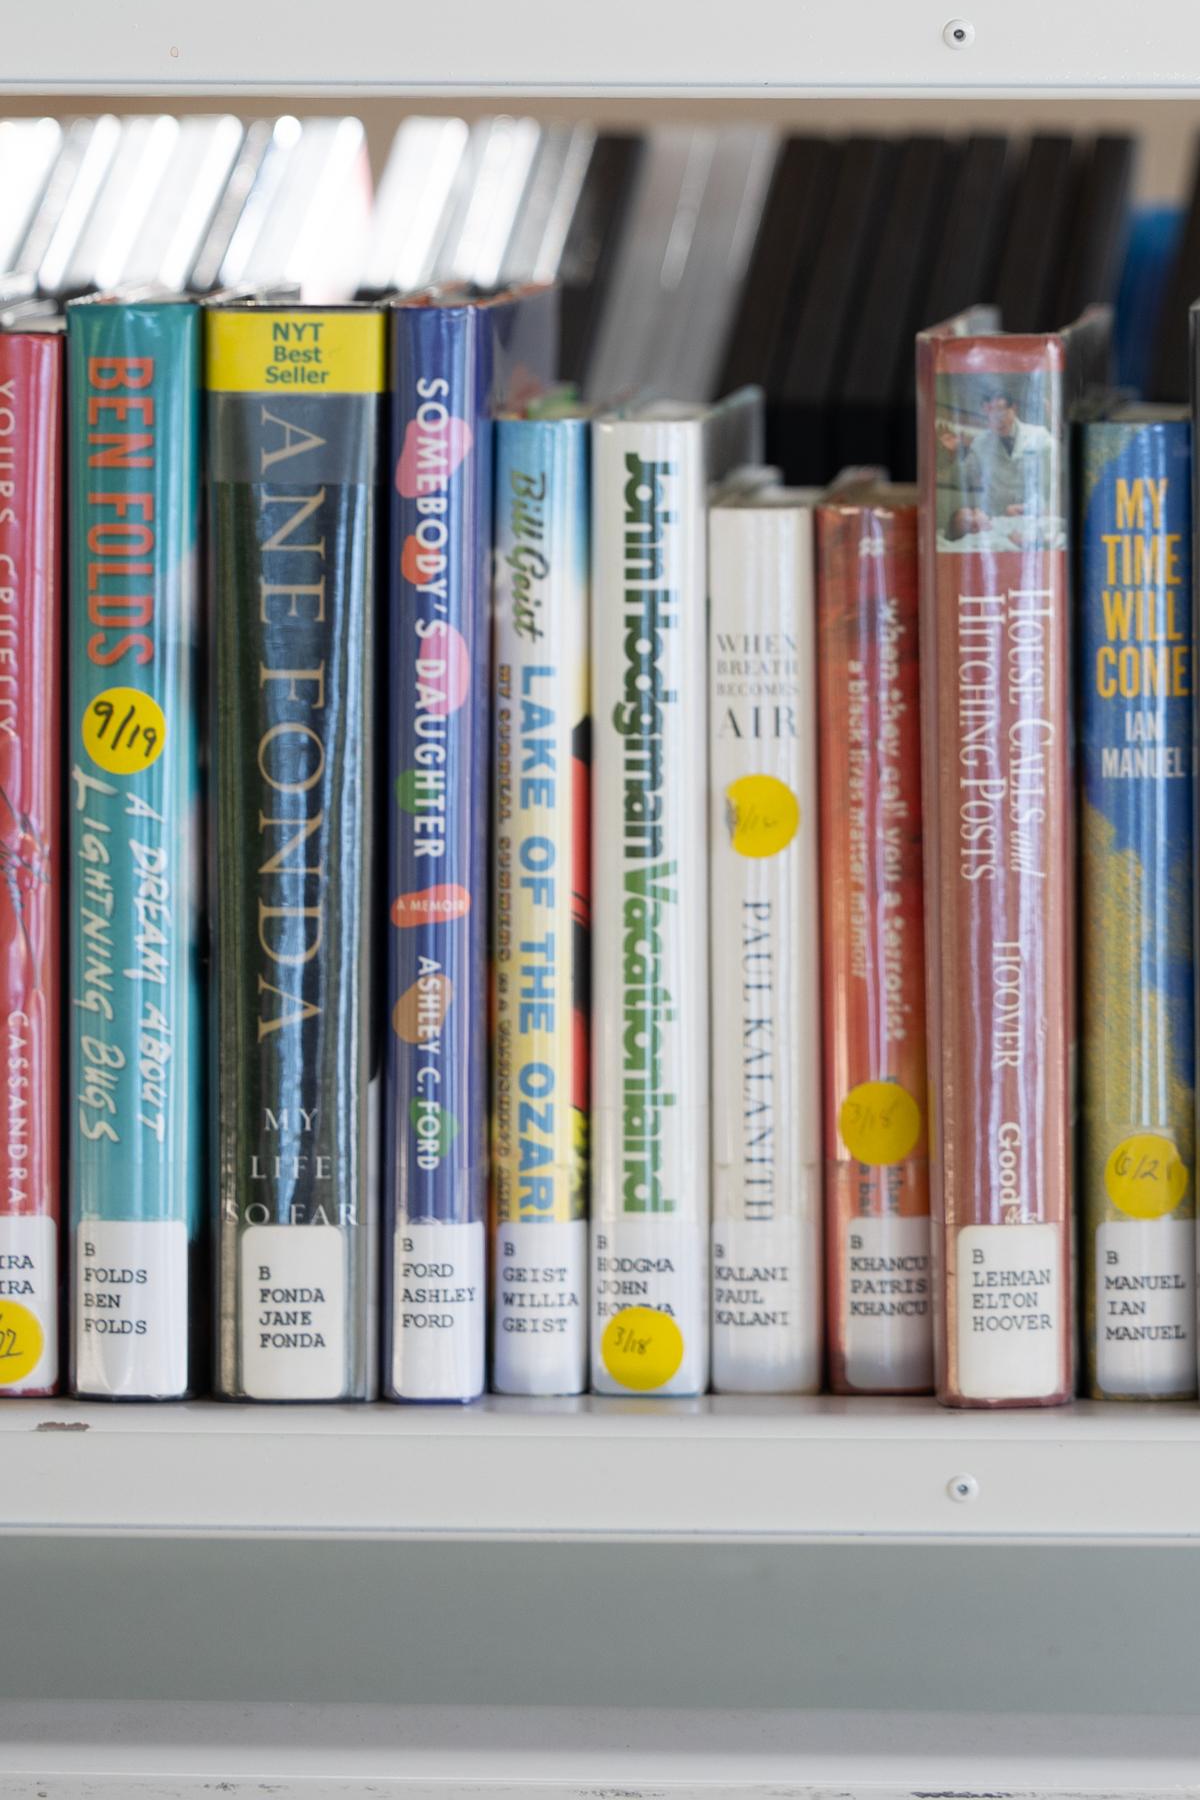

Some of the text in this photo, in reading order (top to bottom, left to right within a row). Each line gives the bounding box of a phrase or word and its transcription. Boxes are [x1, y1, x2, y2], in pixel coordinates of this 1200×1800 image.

[273, 322, 323, 341] NYT
[273, 347, 322, 363] Best
[266, 367, 329, 384] Seller
[88, 356, 154, 667] BEN FOLDS
[1116, 479, 1167, 528] MY
[1102, 535, 1180, 585] TIME
[1103, 592, 1182, 641] WILL
[95, 702, 157, 757] 9/19
[415, 659, 445, 858] DAUGHTER
[520, 666, 557, 1033] LAKE OF THE
[992, 941, 1023, 1068] HOOVER
[624, 861, 678, 1214] Vacationland
[417, 956, 441, 1170] ASHLEY C. FORD
[84, 1267, 147, 1284] FOLDS
[259, 1288, 325, 1303] FONDA
[972, 1269, 1050, 1288] LEHMAN
[259, 1311, 311, 1326] JANE
[972, 1314, 1052, 1332] HOOVER
